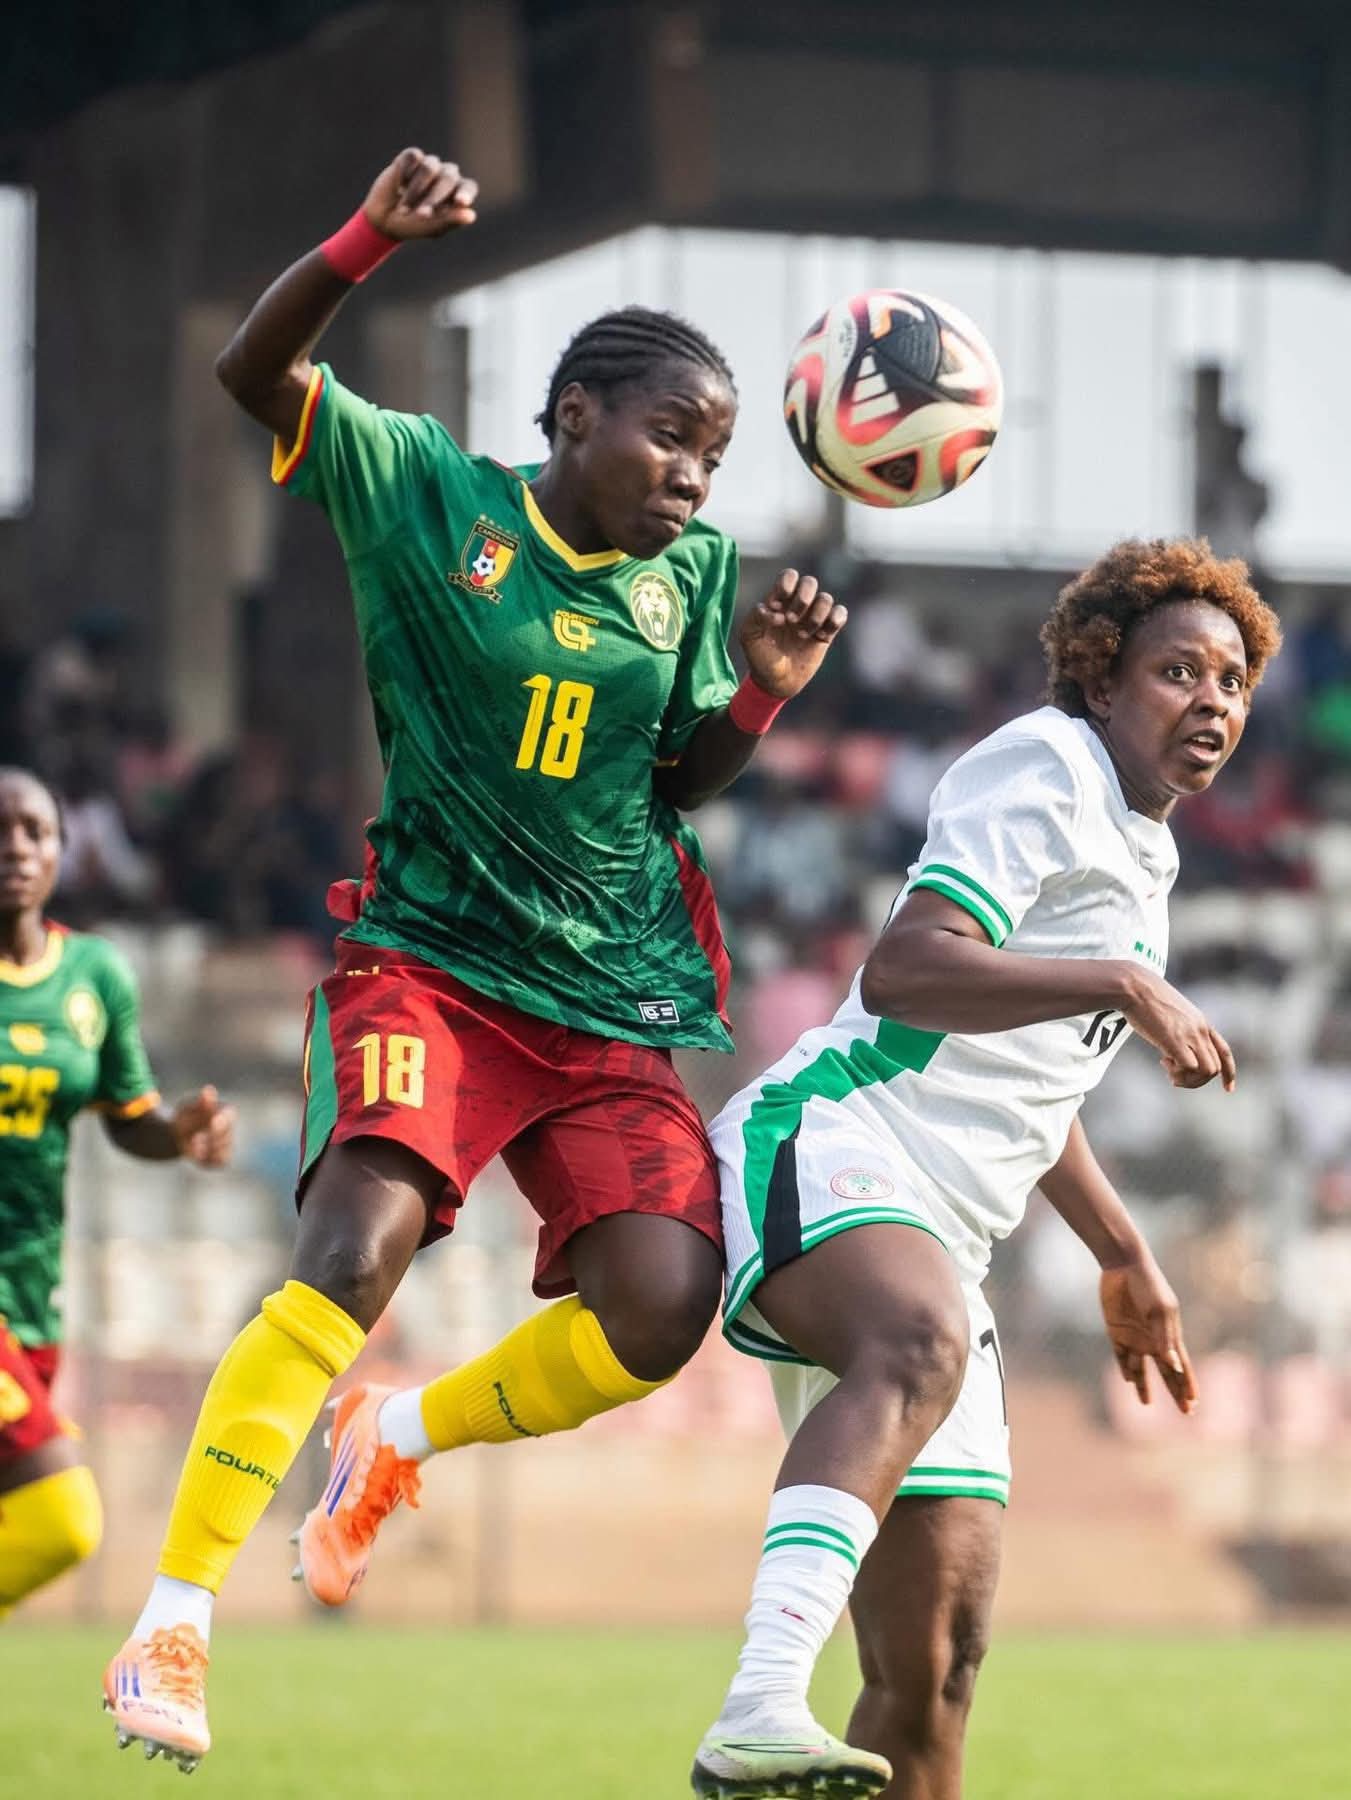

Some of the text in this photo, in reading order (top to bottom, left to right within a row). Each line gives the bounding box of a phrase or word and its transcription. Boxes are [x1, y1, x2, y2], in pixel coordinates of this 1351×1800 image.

[515, 673, 595, 780] 18
[0, 1063, 60, 1139] 25
[352, 1033, 426, 1109] 18
